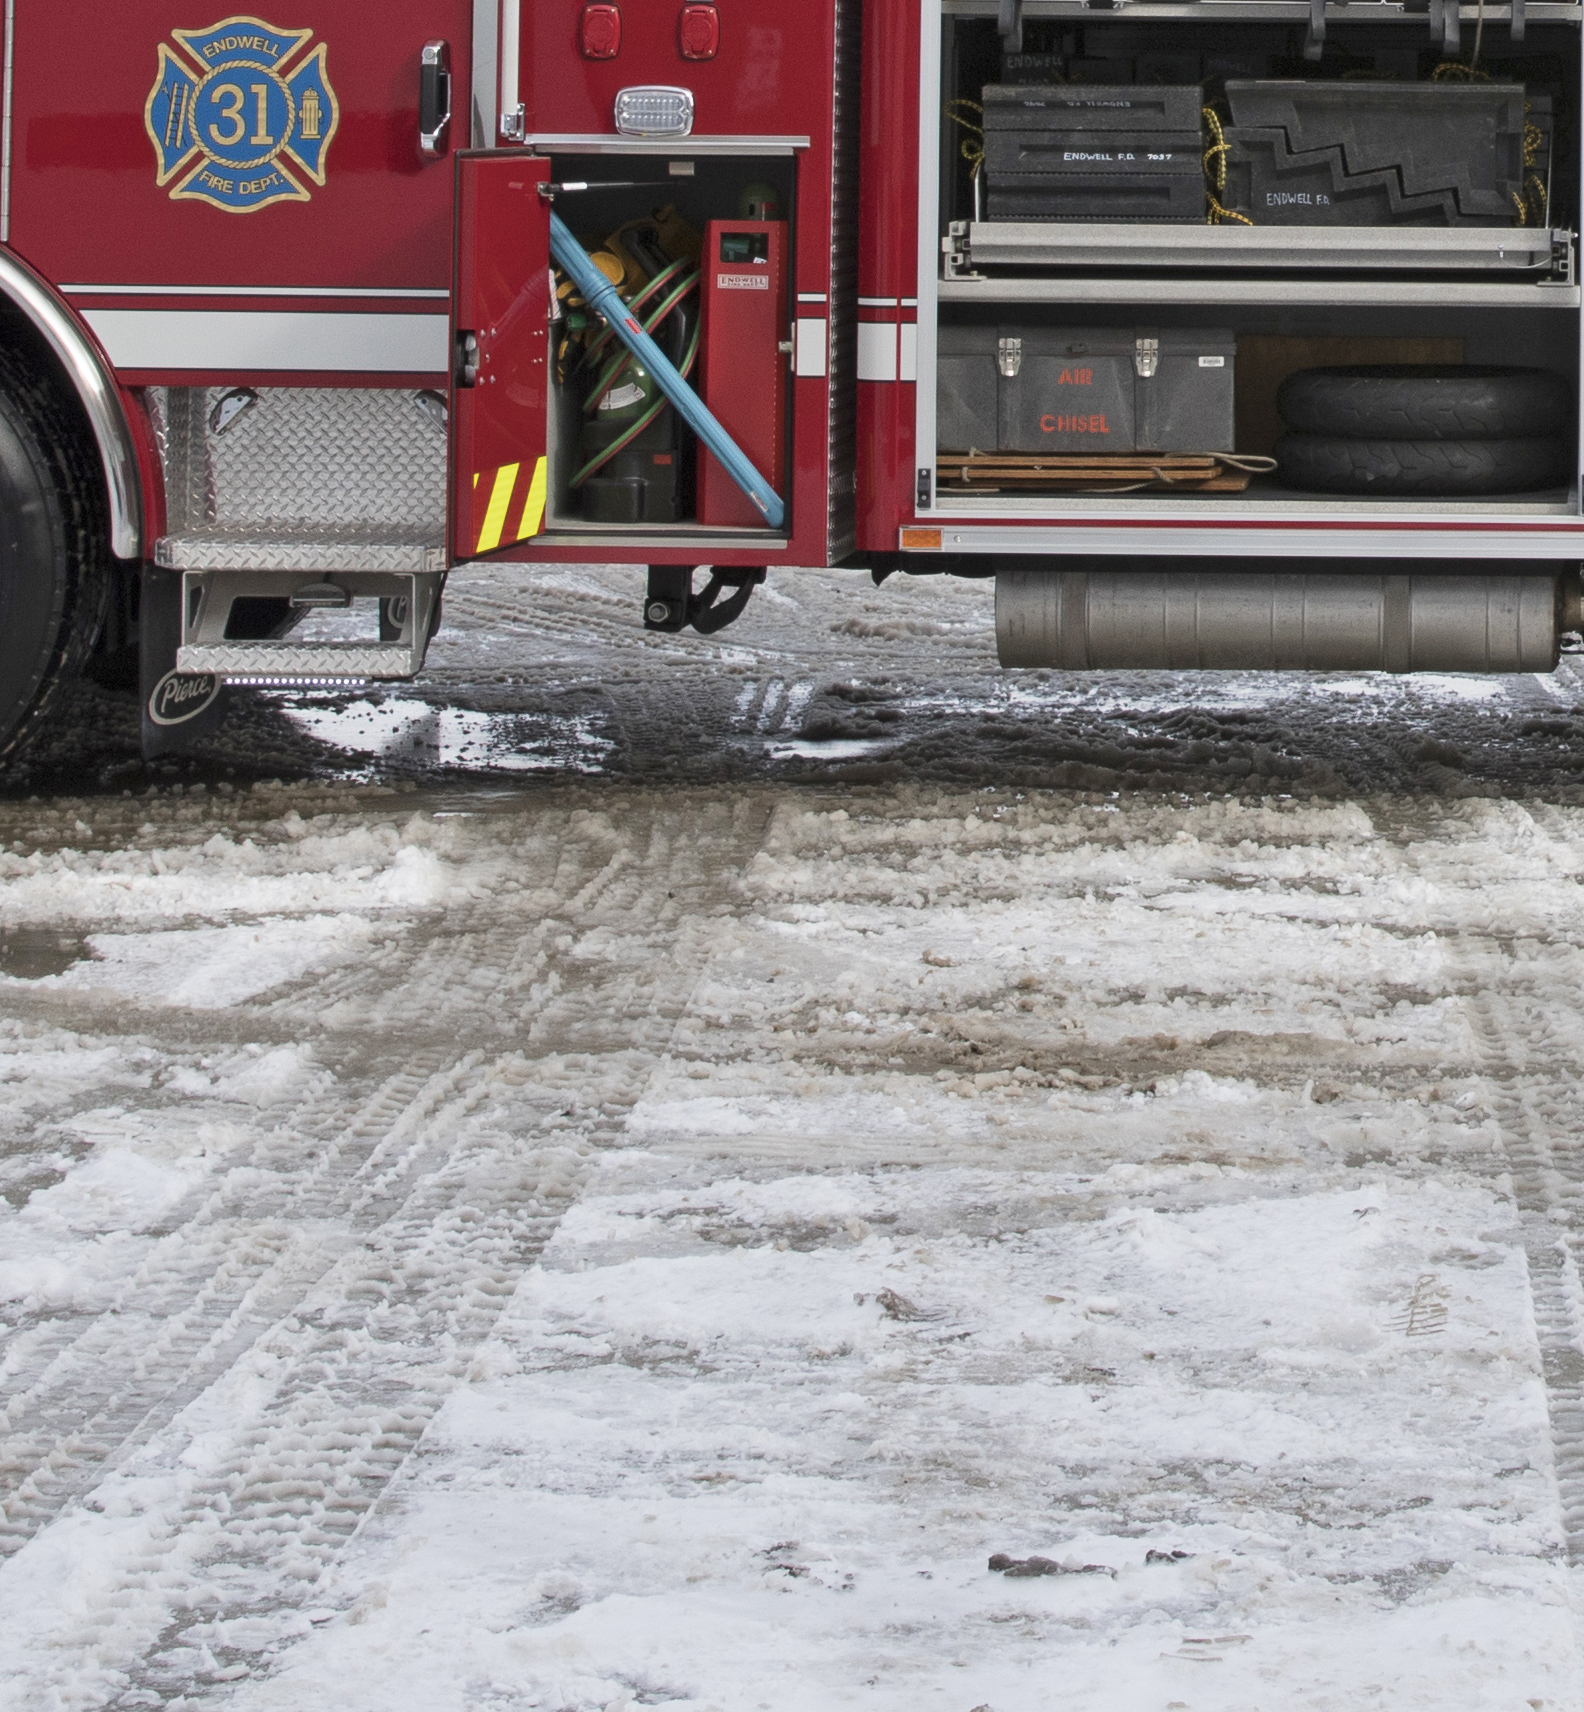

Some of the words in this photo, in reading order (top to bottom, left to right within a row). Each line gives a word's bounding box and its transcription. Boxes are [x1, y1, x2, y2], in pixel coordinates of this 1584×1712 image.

[202, 35, 282, 59] ENDWELL
[208, 83, 274, 146] 31
[1063, 151, 1113, 161] ENDWELL
[199, 169, 234, 195] FIRE
[238, 172, 286, 196] DEPT.
[1265, 192, 1313, 206] ENDWELL
[721, 276, 766, 286] ENDWELL
[1057, 368, 1093, 386] AIR
[1040, 413, 1110, 434] CHISEL
[160, 675, 212, 714] Pierce
